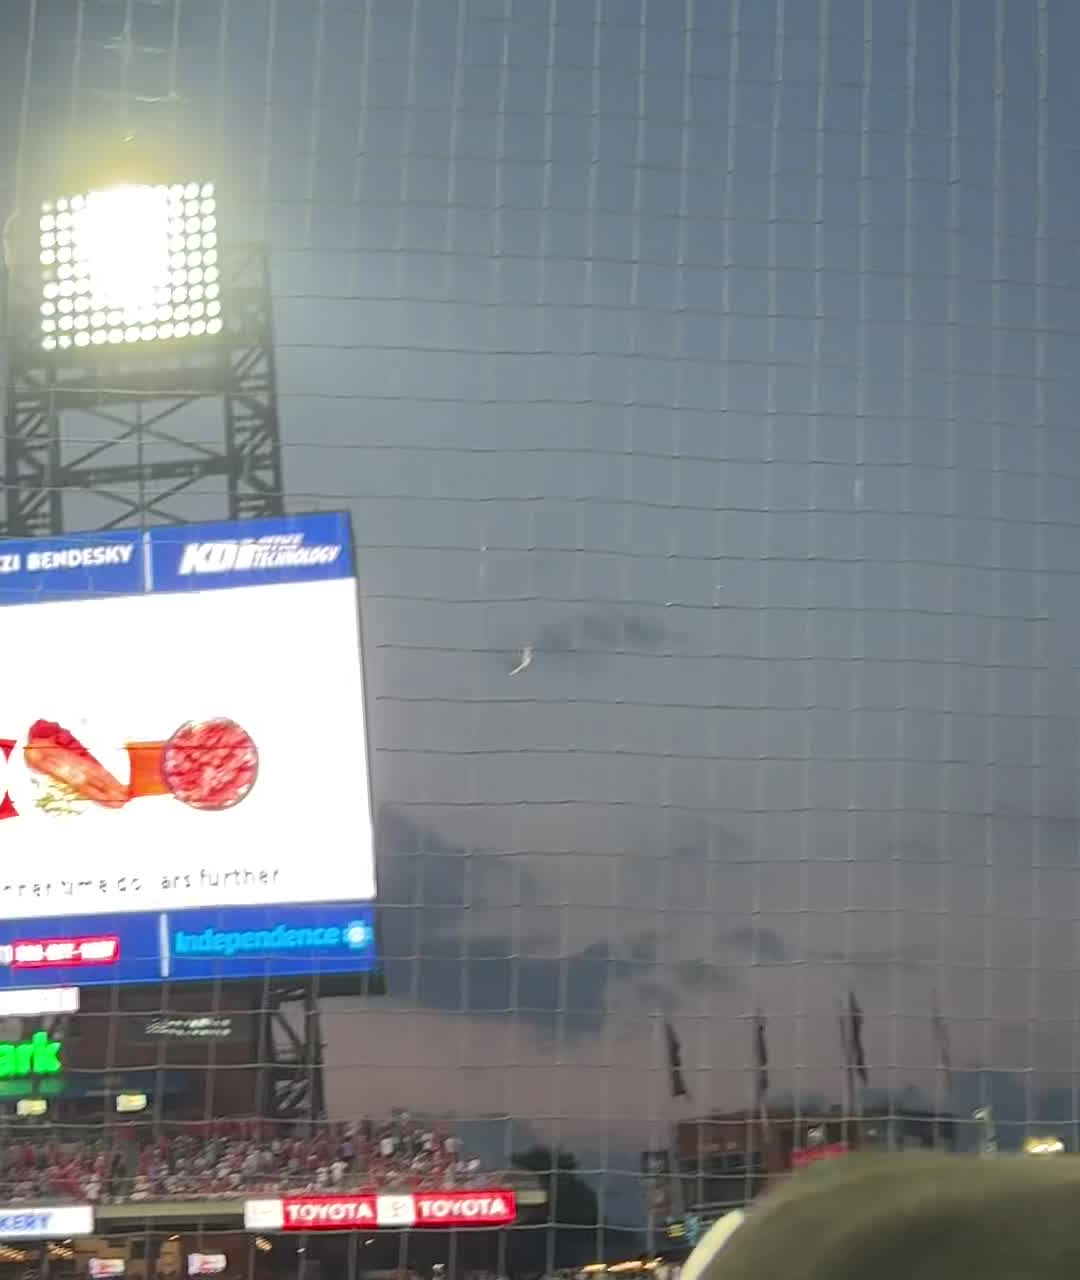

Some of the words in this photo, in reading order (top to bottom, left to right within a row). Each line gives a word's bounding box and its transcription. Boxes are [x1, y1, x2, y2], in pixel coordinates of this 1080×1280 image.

[26, 544, 133, 571] BENDESKY
[199, 868, 279, 889] further
[175, 922, 340, 955] Independence
[286, 1202, 374, 1221] TOYOTA
[420, 1198, 508, 1218] TOYOTA
